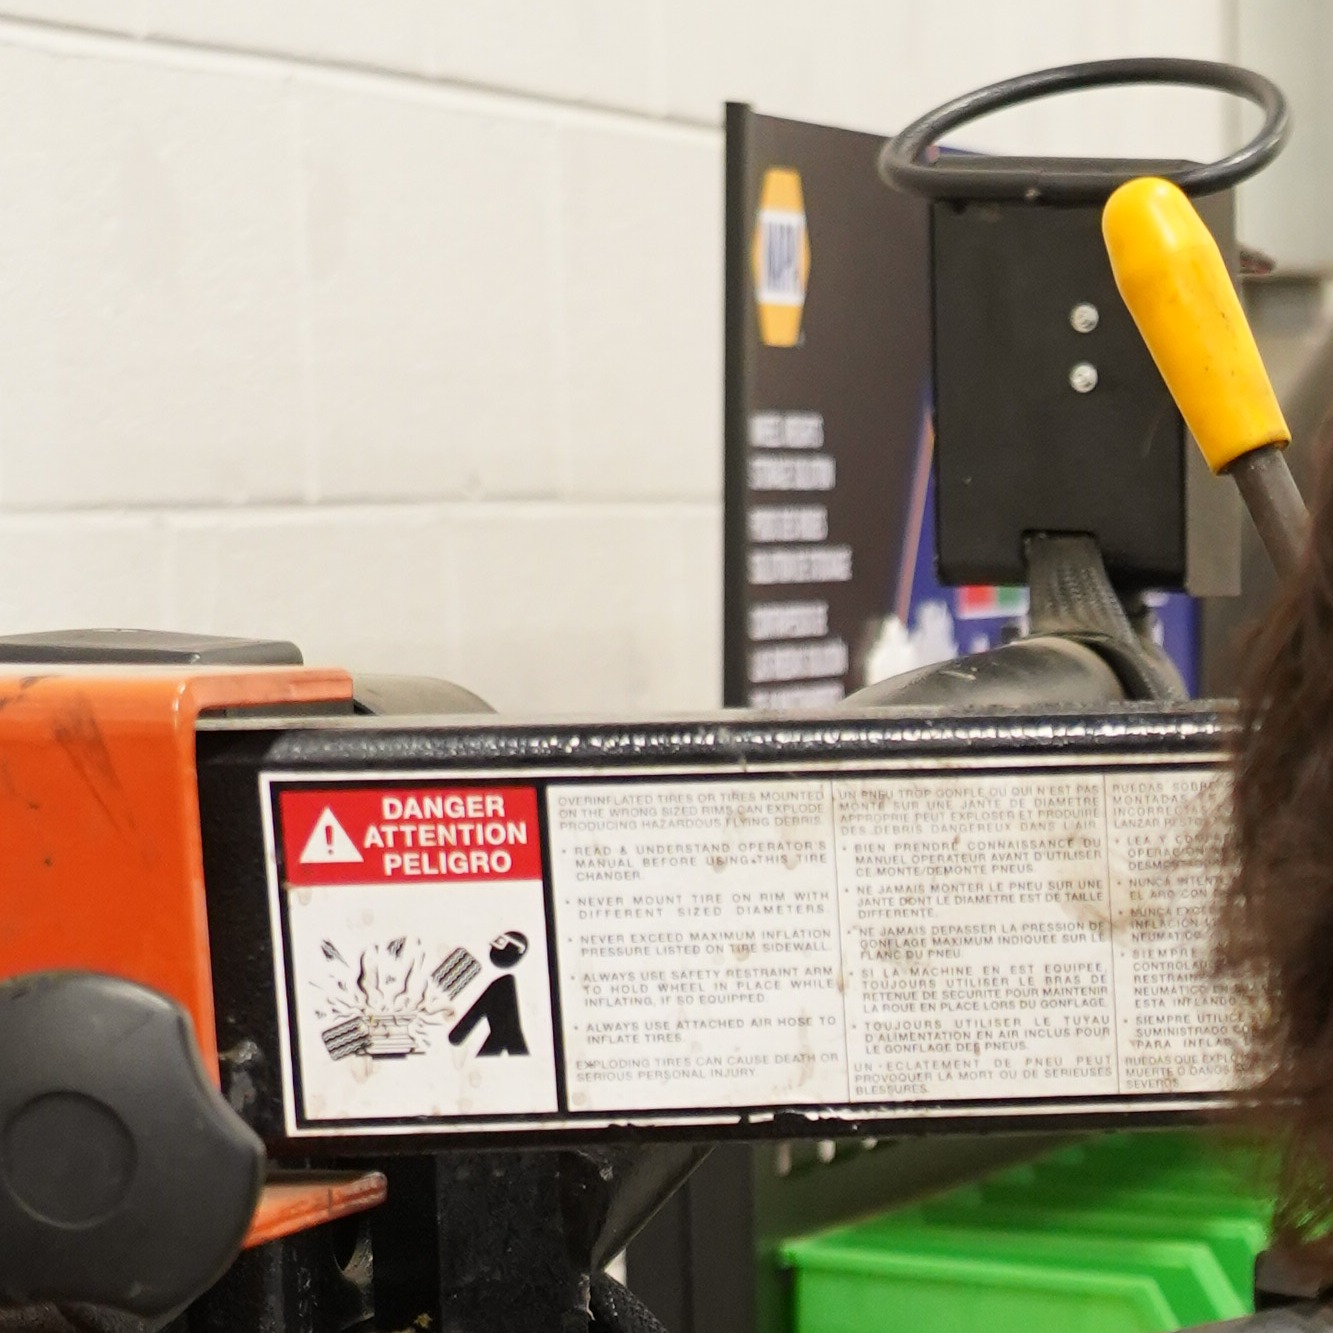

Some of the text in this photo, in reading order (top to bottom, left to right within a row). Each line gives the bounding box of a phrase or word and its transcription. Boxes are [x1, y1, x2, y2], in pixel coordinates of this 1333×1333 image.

[558, 791, 824, 806] OVERINFLATED TIRES OR TIRES MOUNTED
[381, 796, 506, 820] DANGER
[558, 804, 824, 818] ON THE WRONG SIZED RIMS CAN EXPLODE
[559, 820, 637, 831] PRODUCING
[641, 818, 721, 830] HAZARDOUS
[726, 818, 769, 828] FLYING
[363, 822, 528, 849] ATTENTION
[574, 846, 611, 856] READ
[636, 844, 731, 855] UNDERSTAND
[738, 842, 826, 853] OPERATOR'S
[384, 850, 513, 876] PELIGRO
[575, 854, 827, 868] MANUAL BEFORE USING THIS TIRE
[855, 854, 906, 865] MANUEL
[991, 852, 1029, 862] AVANT
[856, 880, 1103, 895] NE JAMAIS MONTER LE PNEU SUR UNE
[577, 892, 829, 906] NEVER MOUNT TIRE ON RIM WITH
[857, 896, 894, 907] JANTE
[899, 896, 932, 906] DONT
[936, 895, 950, 905] LE
[1020, 893, 1041, 904] EST
[1045, 893, 1061, 903] DE
[1065, 892, 1103, 903] TAILLE
[578, 908, 663, 919] DIFFERENT
[677, 906, 721, 917] SIZED
[580, 930, 831, 944] NEVER EXCEED MAXIMUM INFLATION
[580, 946, 650, 957] PRESSURE
[656, 945, 701, 956] LISTED
[705, 945, 724, 955] ON
[730, 944, 757, 954] TIRE
[582, 967, 833, 982] ALWAYS USE SAFETY RESTRAINT ARM
[861, 968, 874, 978] SI
[883, 968, 899, 978] LA
[909, 966, 972, 977] MACHINE
[983, 966, 1000, 976] EN
[1010, 965, 1034, 975] EST
[582, 979, 836, 994] TO HOLD WHEEL IN PLACE WHILE
[862, 975, 1106, 989] TOUJOURS UTILISER LE BRAS DE
[584, 995, 655, 1006] INFLATING,
[661, 995, 672, 1005] IF
[677, 994, 694, 1005] SO
[862, 990, 917, 1001] RETENUE
[922, 990, 937, 1000] DE
[1005, 987, 1038, 998] POUR
[1042, 986, 1108, 997] MAINTENIR
[863, 1003, 878, 1013] LA
[882, 1002, 915, 1013] ROUE
[920, 1002, 936, 1012] EN
[940, 1001, 979, 1011] PLACE
[983, 1000, 1015, 1010] LORS
[1020, 999, 1036, 1009] DU
[586, 1017, 836, 1032] ALWAYS USE ATTACHED AIR HOSE TO
[865, 1015, 1110, 1031] TOUJOURS UTILISER LE TUYAU
[587, 1033, 639, 1044] INFLATE
[976, 1030, 993, 1040] EN
[999, 1029, 1019, 1039] AIR
[1024, 1028, 1070, 1039] INCLUS
[1075, 1027, 1110, 1038] POUR
[865, 1044, 880, 1055] LE
[884, 1043, 951, 1054] GONFLAGE
[956, 1042, 980, 1053] DES
[575, 1053, 839, 1069] EXPLODING TIRES CAN CAUSE DEATH OR
[577, 1070, 632, 1081] SERIOUS
[638, 1069, 705, 1080] PERSONAL
